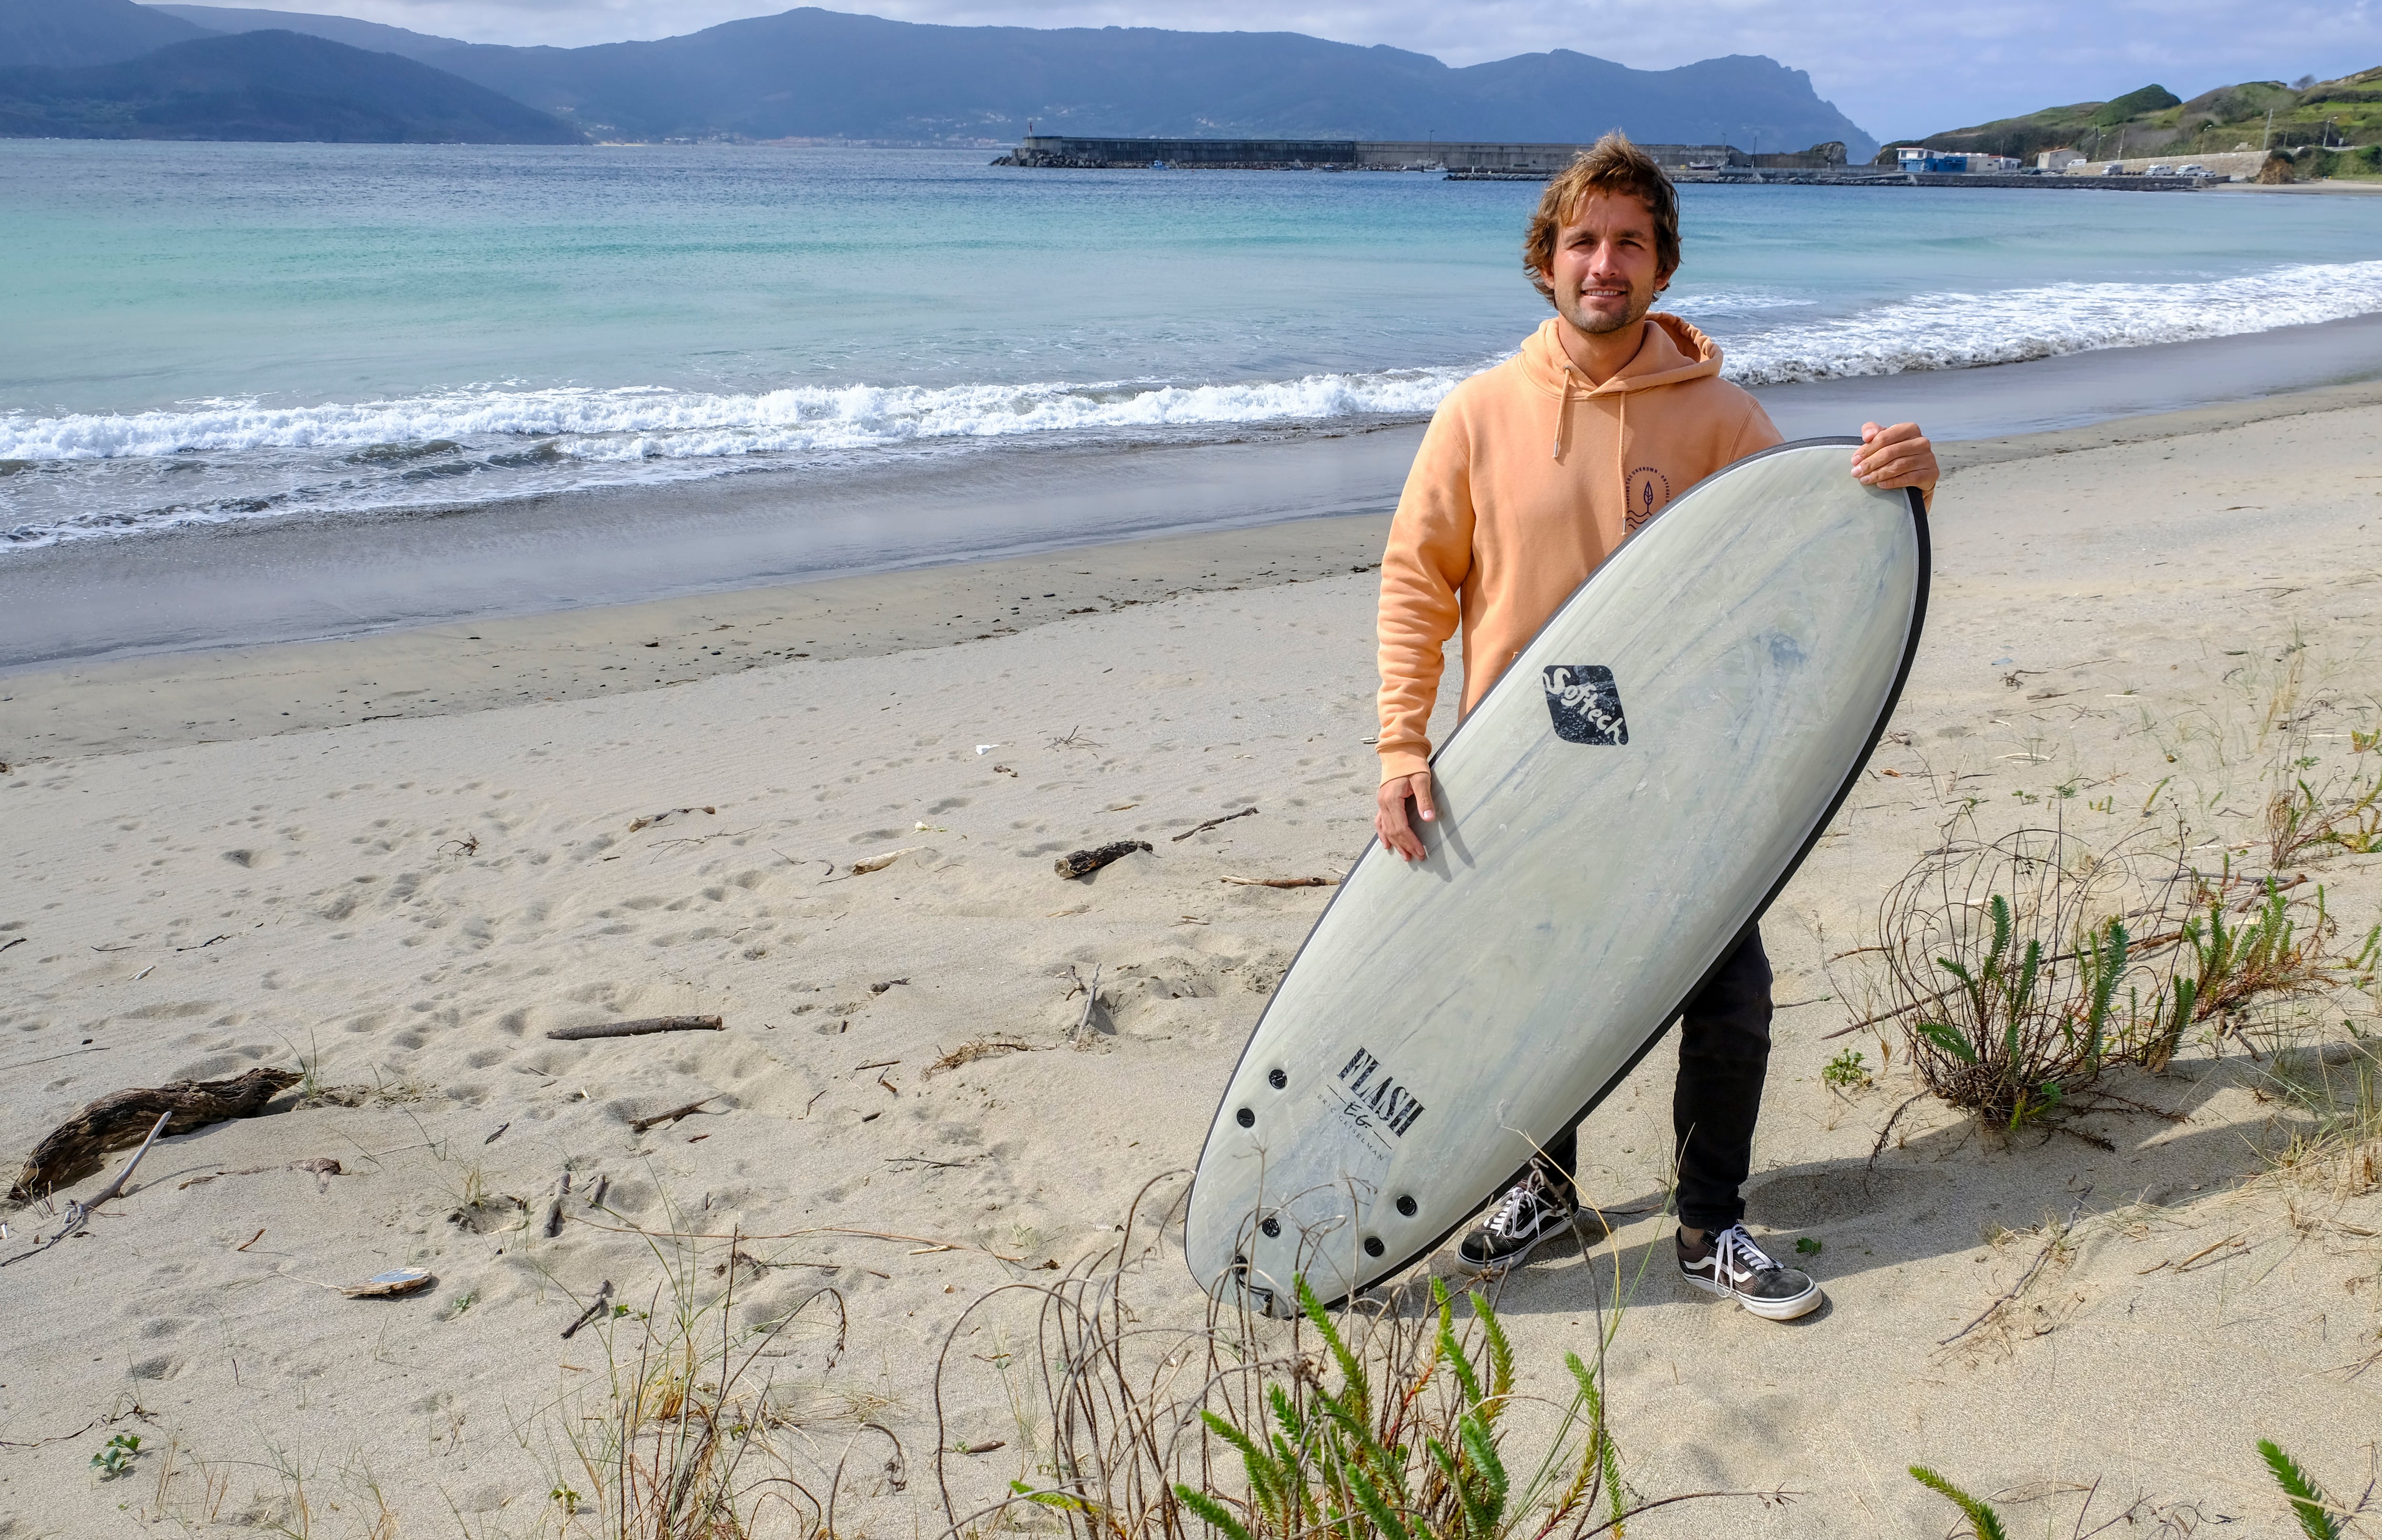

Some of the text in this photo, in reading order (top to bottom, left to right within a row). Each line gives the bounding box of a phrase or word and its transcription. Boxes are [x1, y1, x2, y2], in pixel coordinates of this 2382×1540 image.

[1632, 466, 1658, 475] UNKNOWN
[1661, 475, 1670, 499] ORTEGAL
[1542, 667, 1624, 745] Softech
[1336, 1045, 1426, 1139] FLASH
[1343, 1101, 1372, 1128] E.G.
[1317, 1094, 1384, 1161] ERIC GEISELMAN
